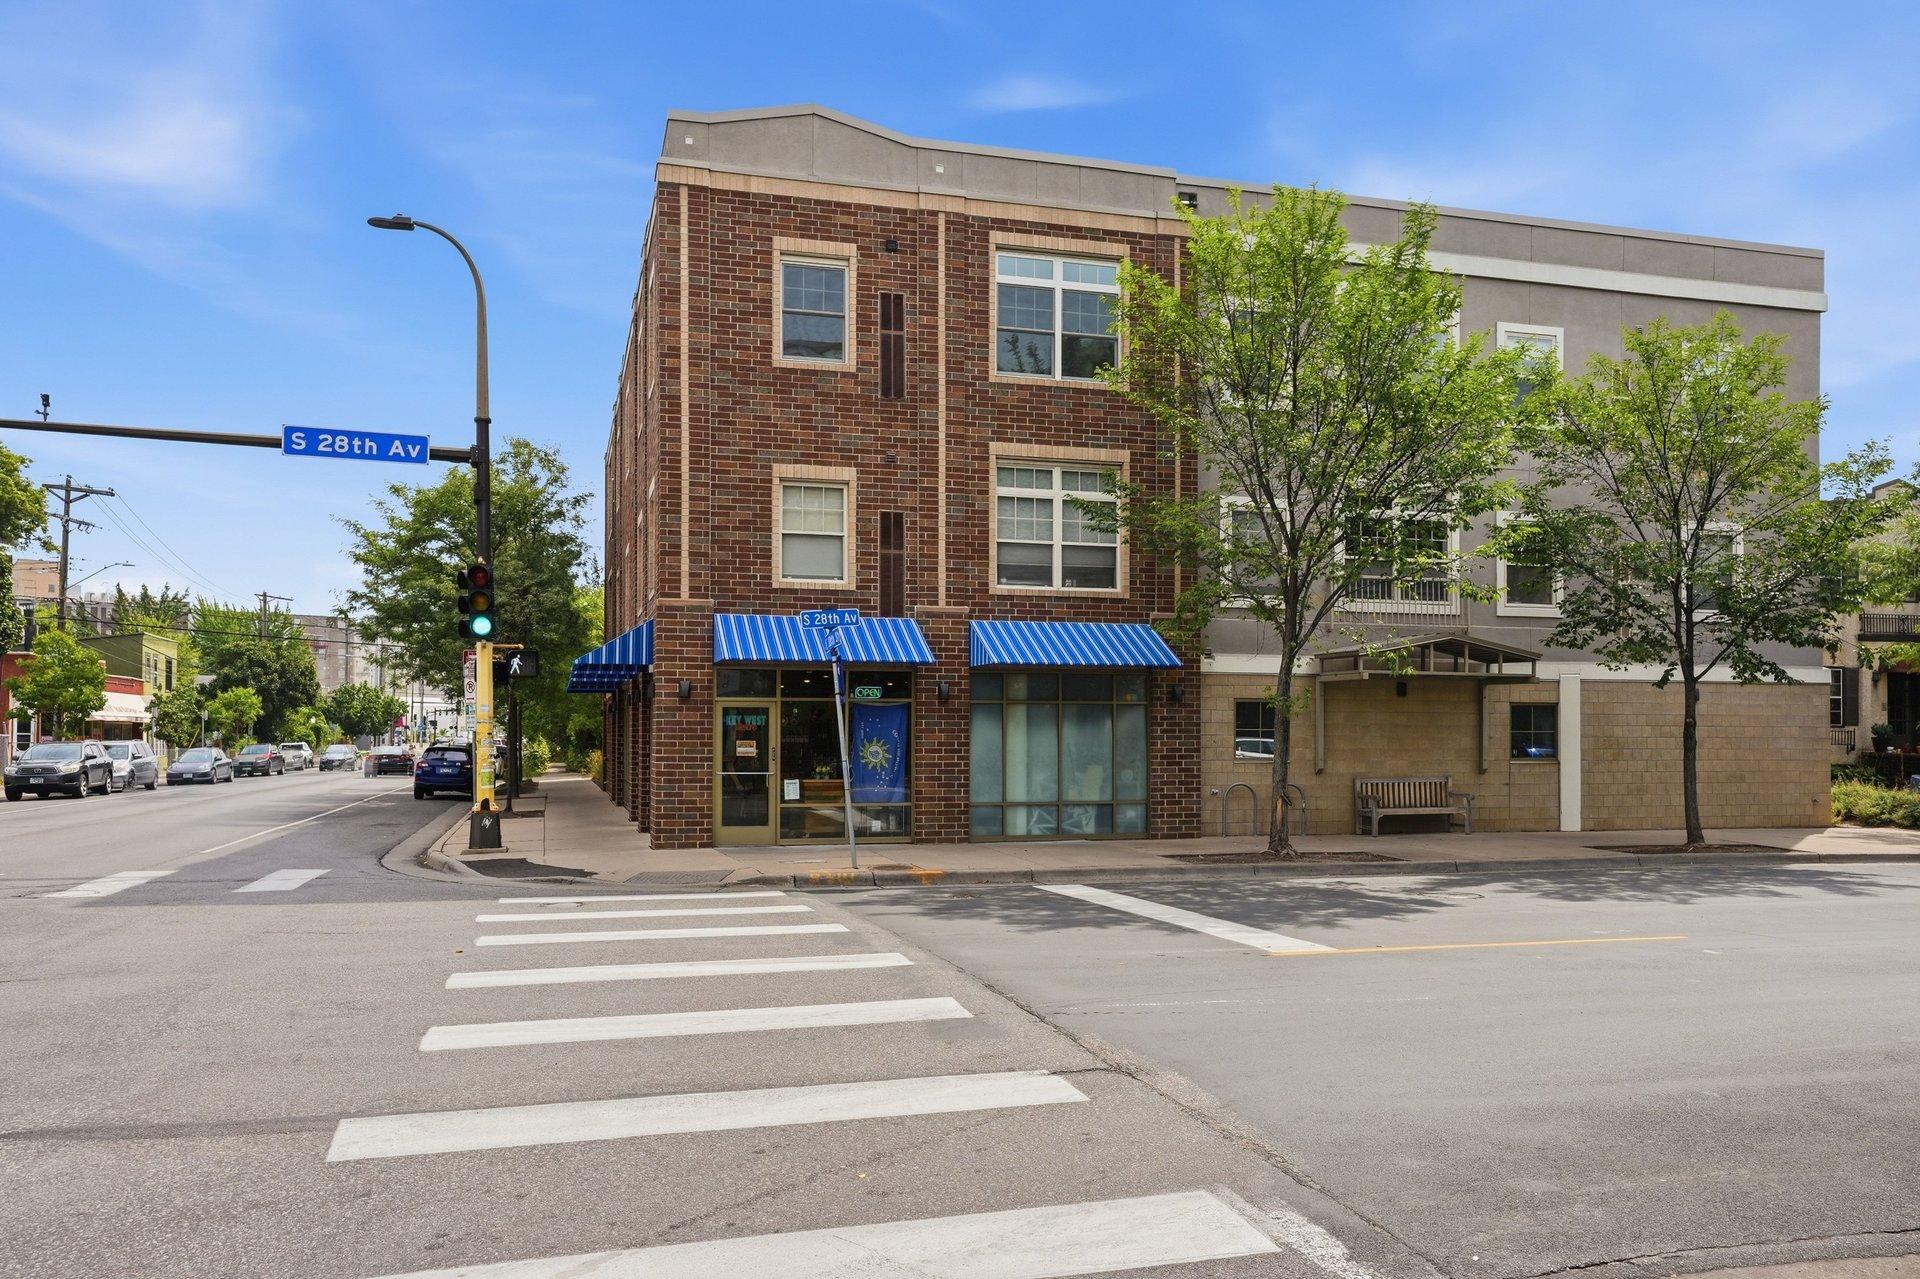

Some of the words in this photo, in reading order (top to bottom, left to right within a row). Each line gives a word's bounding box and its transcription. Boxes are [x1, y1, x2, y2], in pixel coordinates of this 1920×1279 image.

[291, 432, 306, 450] S
[317, 434, 378, 455] 28th
[388, 439, 421, 458] Av
[803, 614, 811, 626] S
[814, 612, 840, 625] 28th
[844, 612, 857, 624] Av
[856, 688, 880, 697] OPEN
[743, 714, 767, 726] WEST
